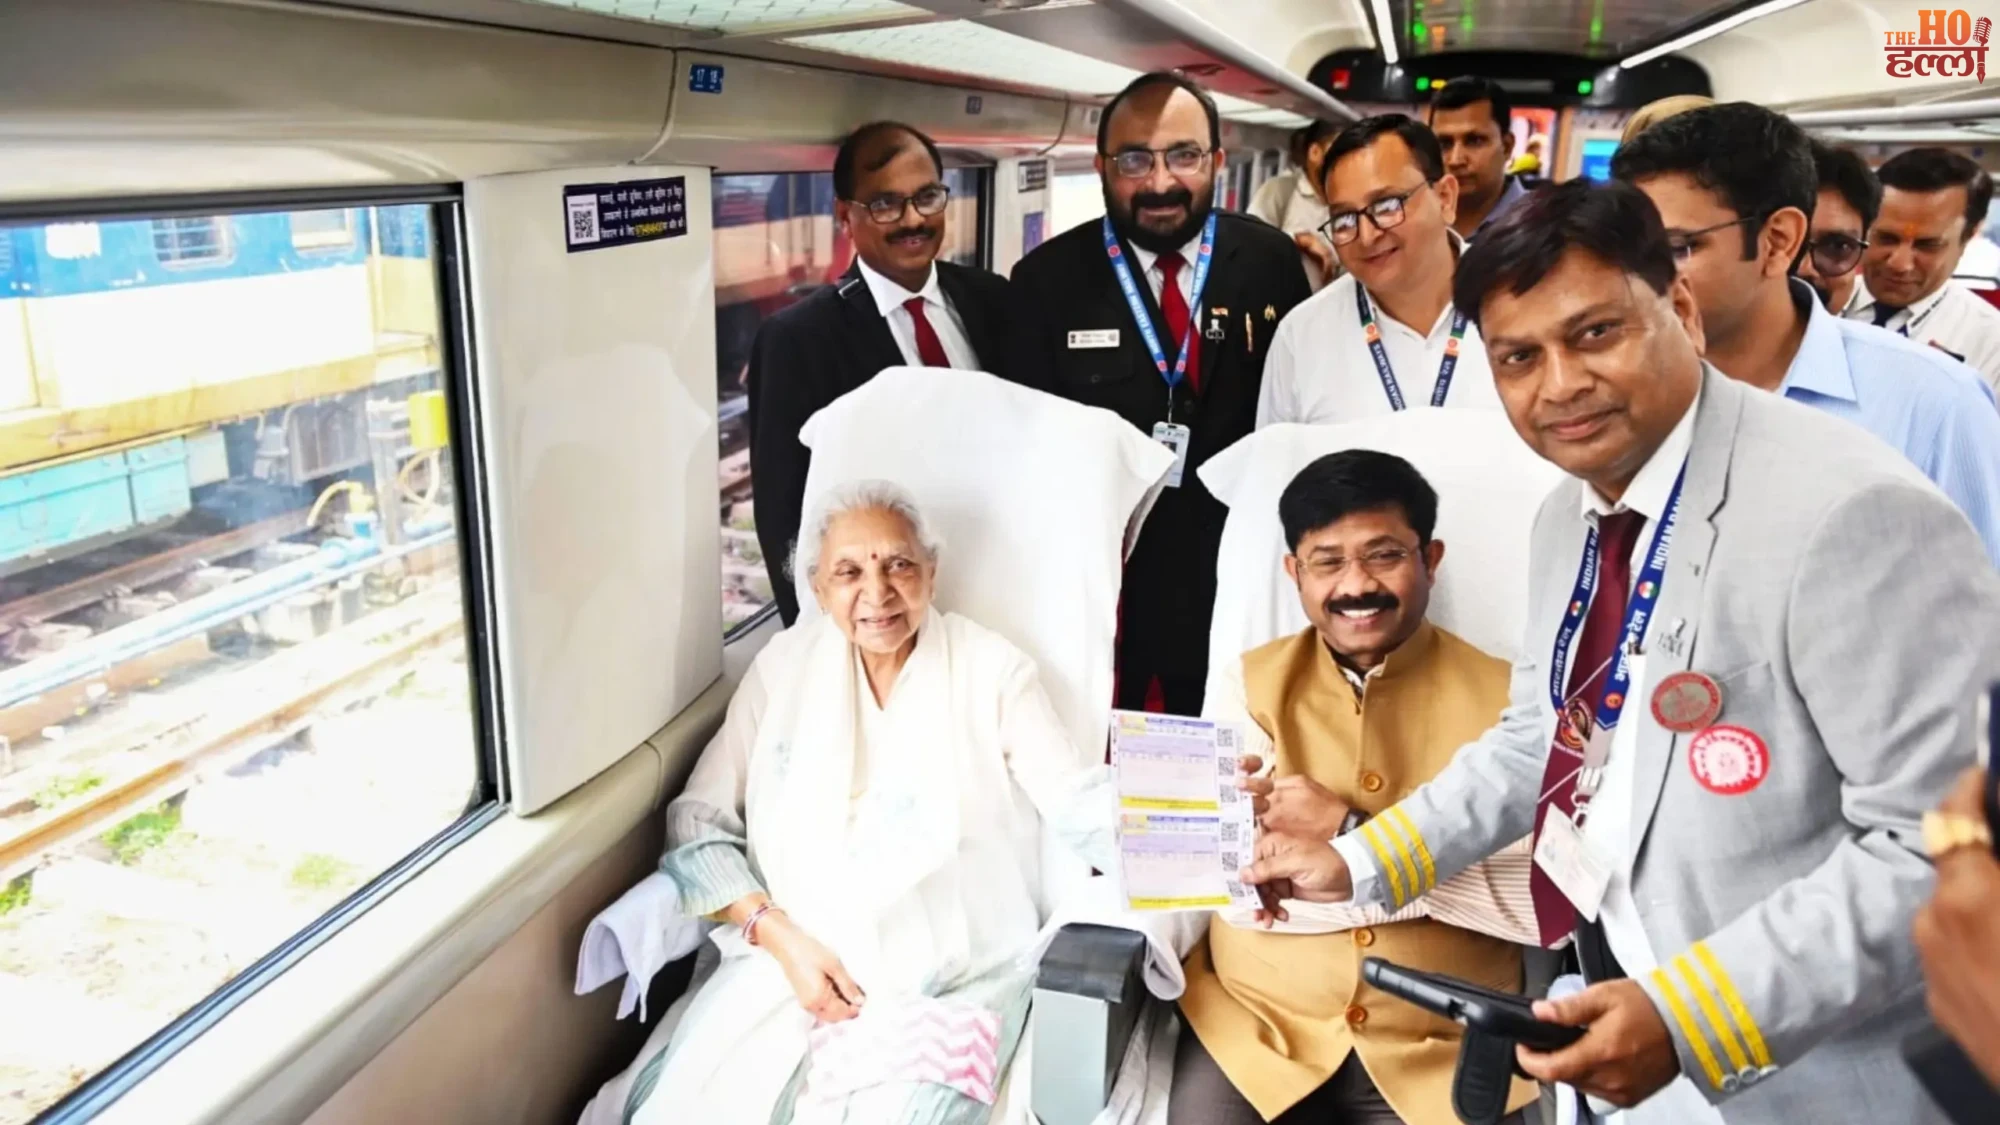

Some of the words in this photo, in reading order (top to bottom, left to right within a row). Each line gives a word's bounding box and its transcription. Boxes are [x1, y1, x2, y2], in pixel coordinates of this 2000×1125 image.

[1372, 343, 1394, 385] RAILWAYS
[1580, 547, 1596, 590] INDIAN
[1649, 523, 1674, 571] INDIAN
